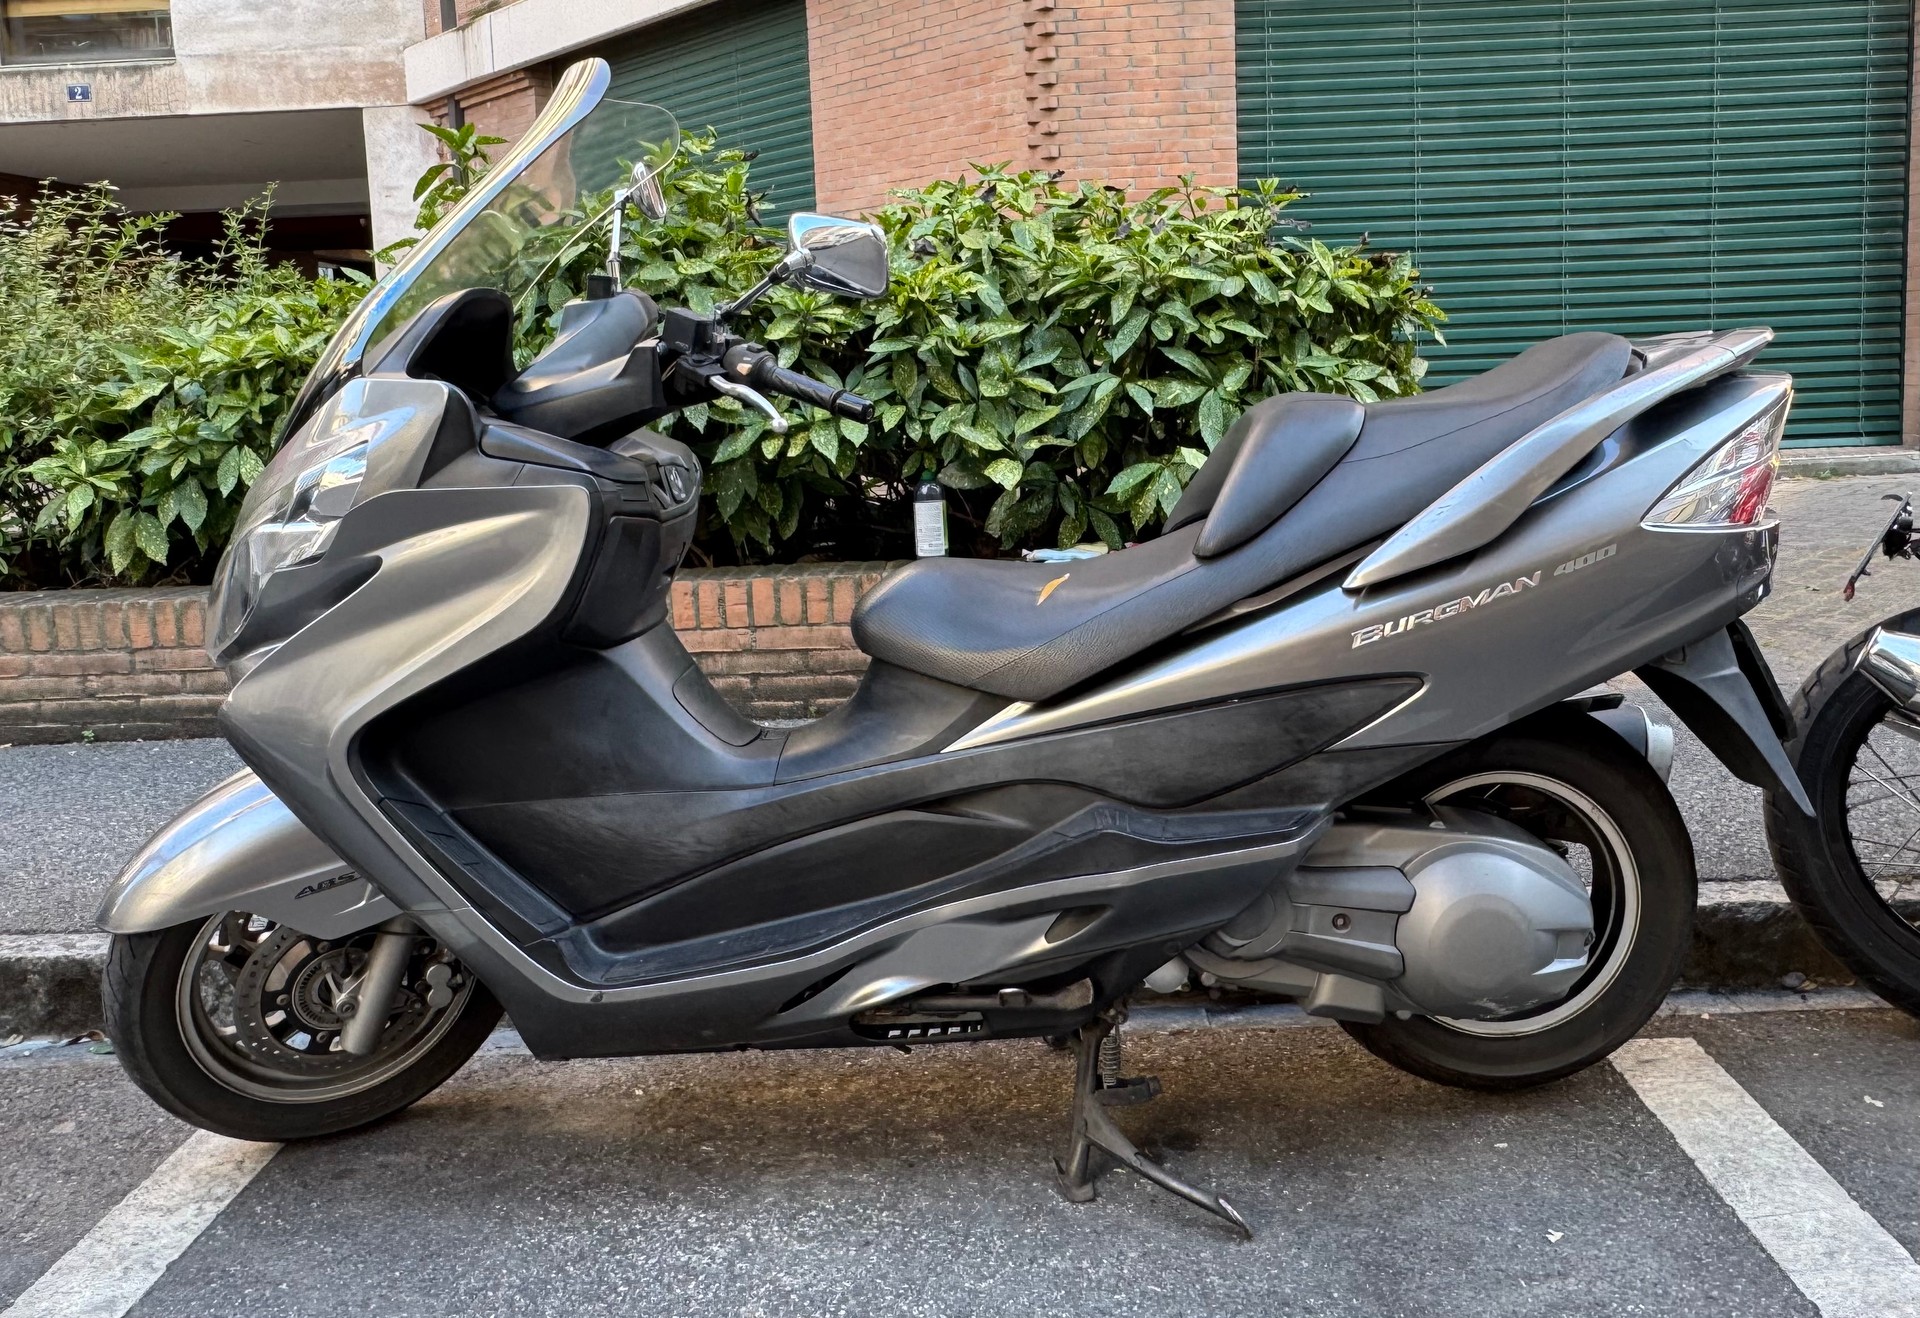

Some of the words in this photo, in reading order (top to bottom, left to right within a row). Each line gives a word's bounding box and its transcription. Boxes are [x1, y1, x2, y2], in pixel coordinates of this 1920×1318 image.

[74, 86, 83, 100] 2
[1350, 570, 1542, 650] BURGMAN
[1553, 543, 1617, 577] 400
[294, 871, 361, 899] ABS
